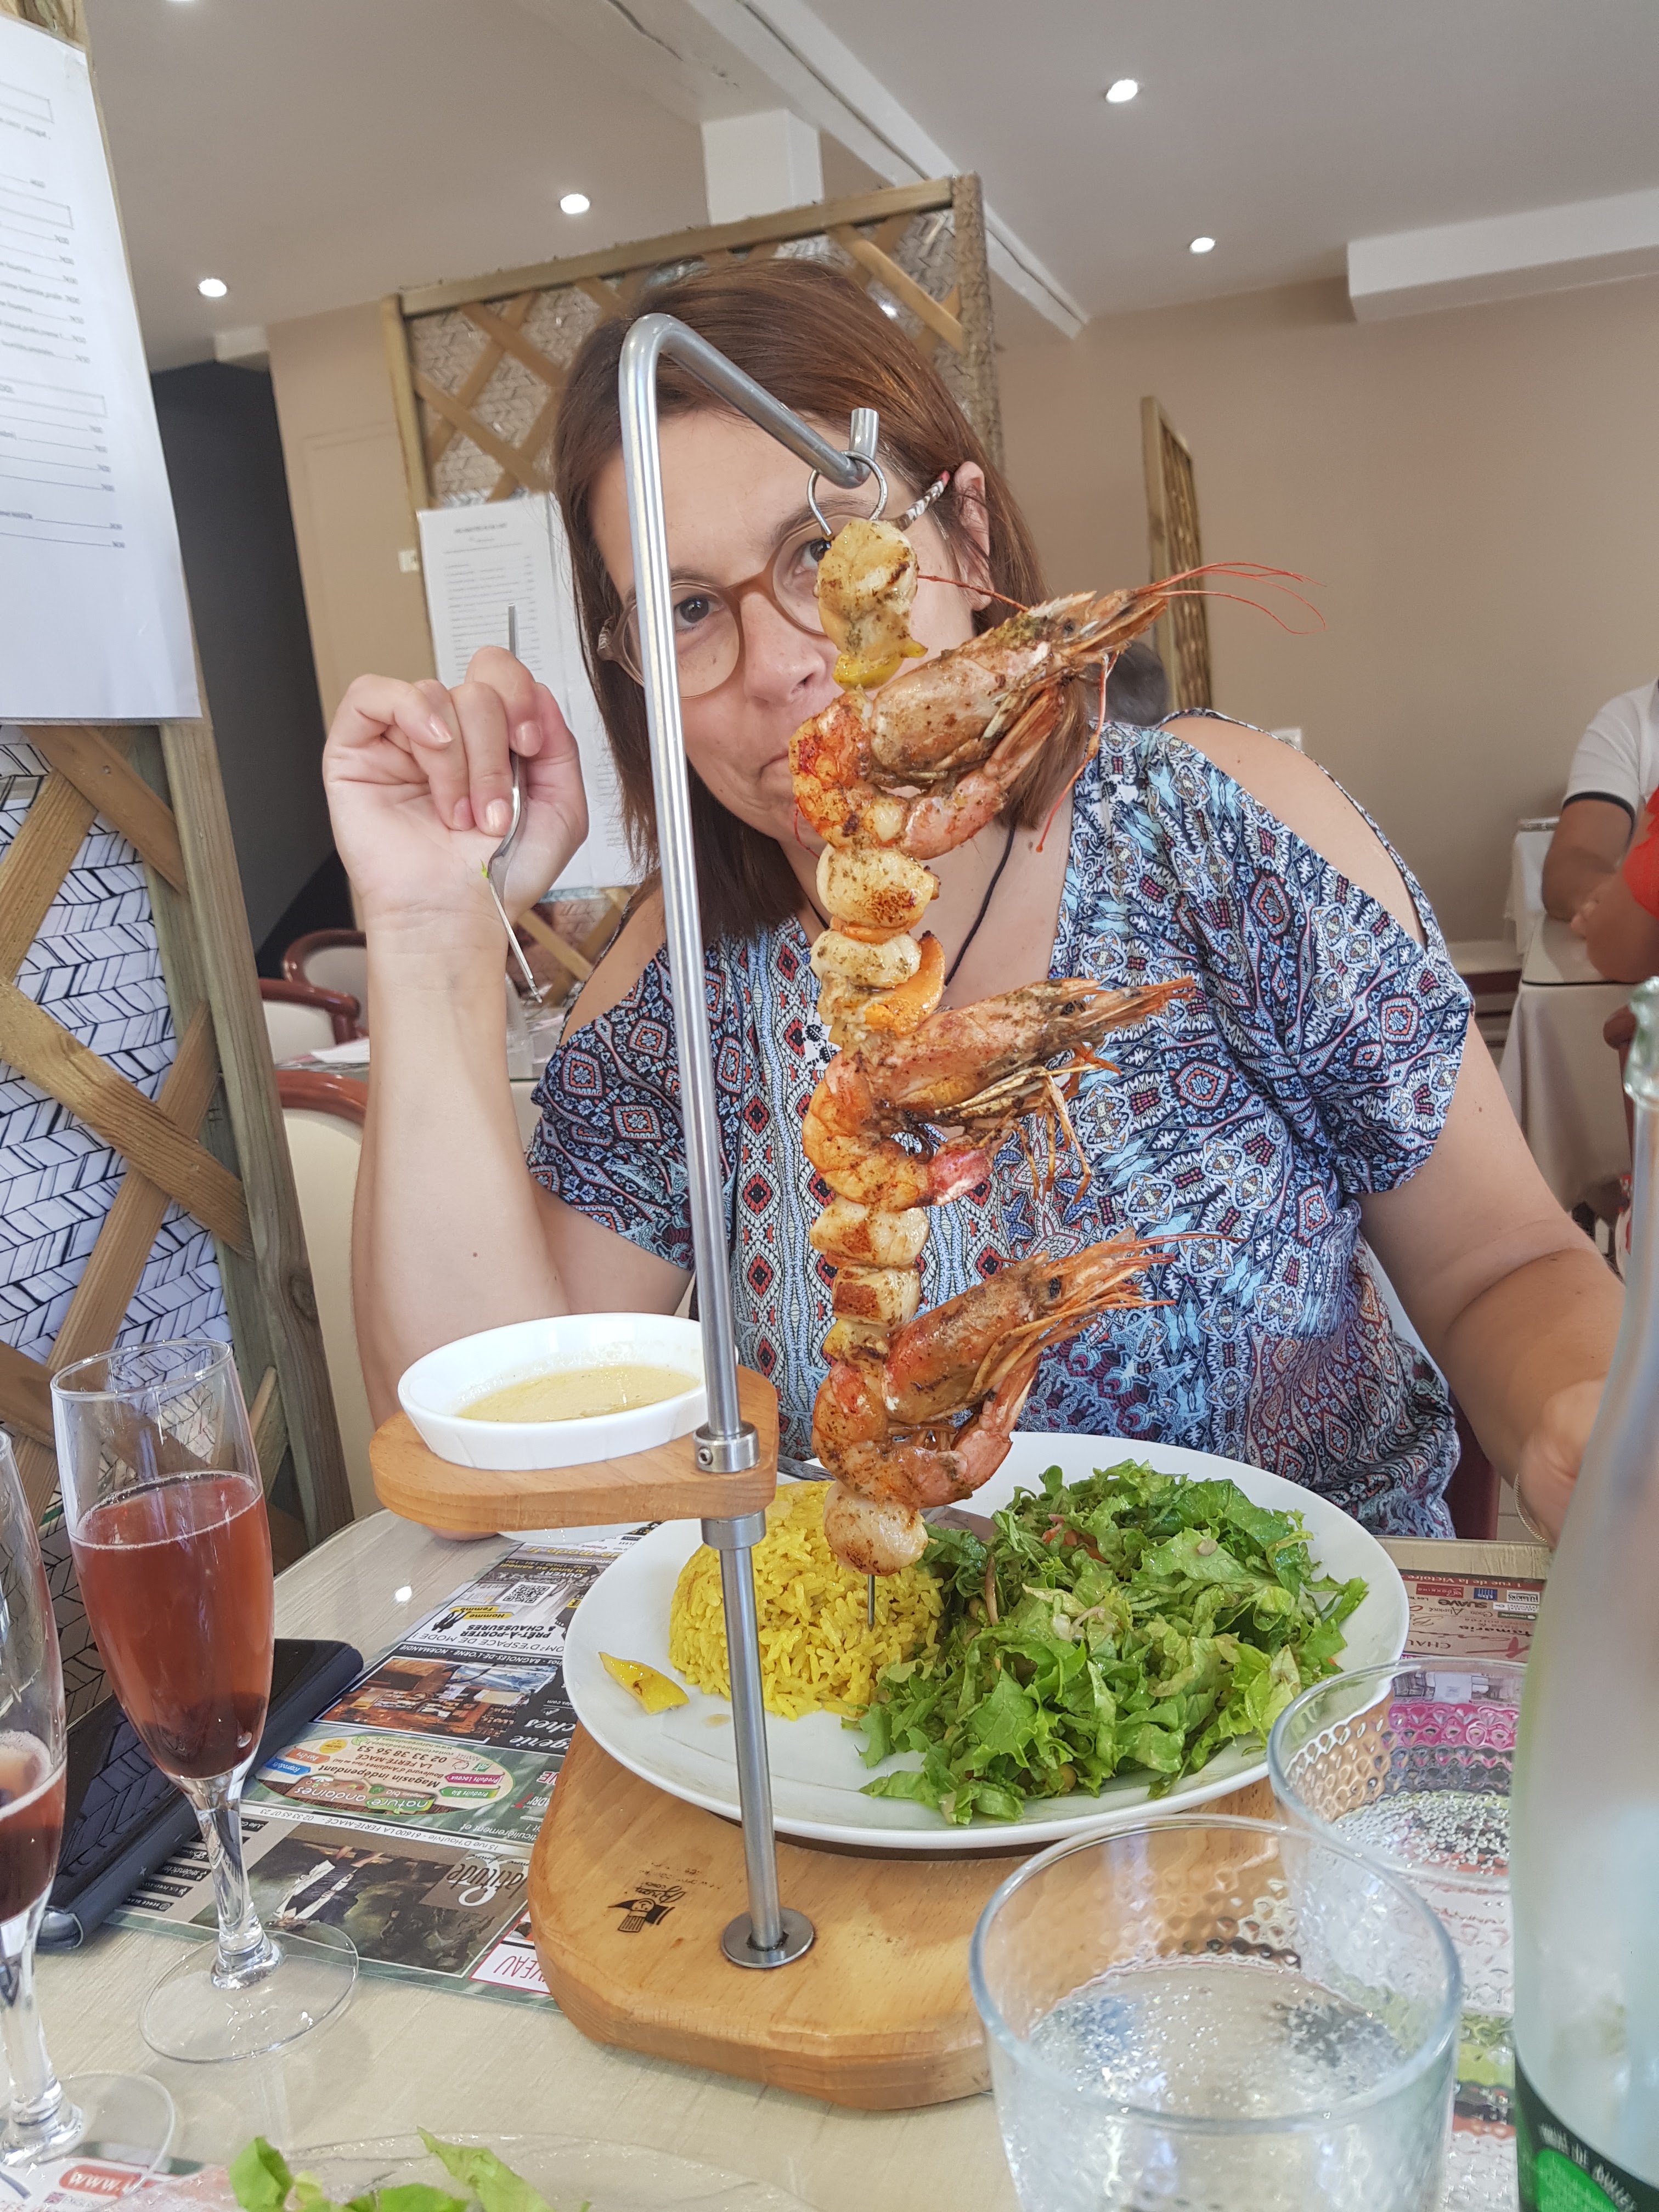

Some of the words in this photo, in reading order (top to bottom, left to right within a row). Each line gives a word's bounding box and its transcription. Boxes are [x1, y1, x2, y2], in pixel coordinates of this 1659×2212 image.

[1407, 1575, 1454, 1583] Victoire
[421, 1633, 458, 1642] MODE
[460, 1630, 551, 1639] PRÊT-À-PORTER
[478, 1638, 540, 1650] D'ESPACE
[398, 1645, 448, 1654] NORMANDIE
[354, 1754, 417, 1768] FERTÉ-MACÉ
[413, 1753, 428, 1761] 33
[318, 1765, 388, 1781] indépendant
[405, 1769, 444, 1779] Boulevard
[391, 1774, 441, 1788] Magasin
[294, 1786, 366, 1802] andaines
[386, 1790, 401, 1798] bio
[370, 1798, 429, 1808] nature
[326, 1818, 381, 1832] FERTÉ-MACÉ
[396, 1829, 422, 1838] 61600
[447, 1864, 527, 1899] latitude
[493, 1956, 545, 1982] VEAU
